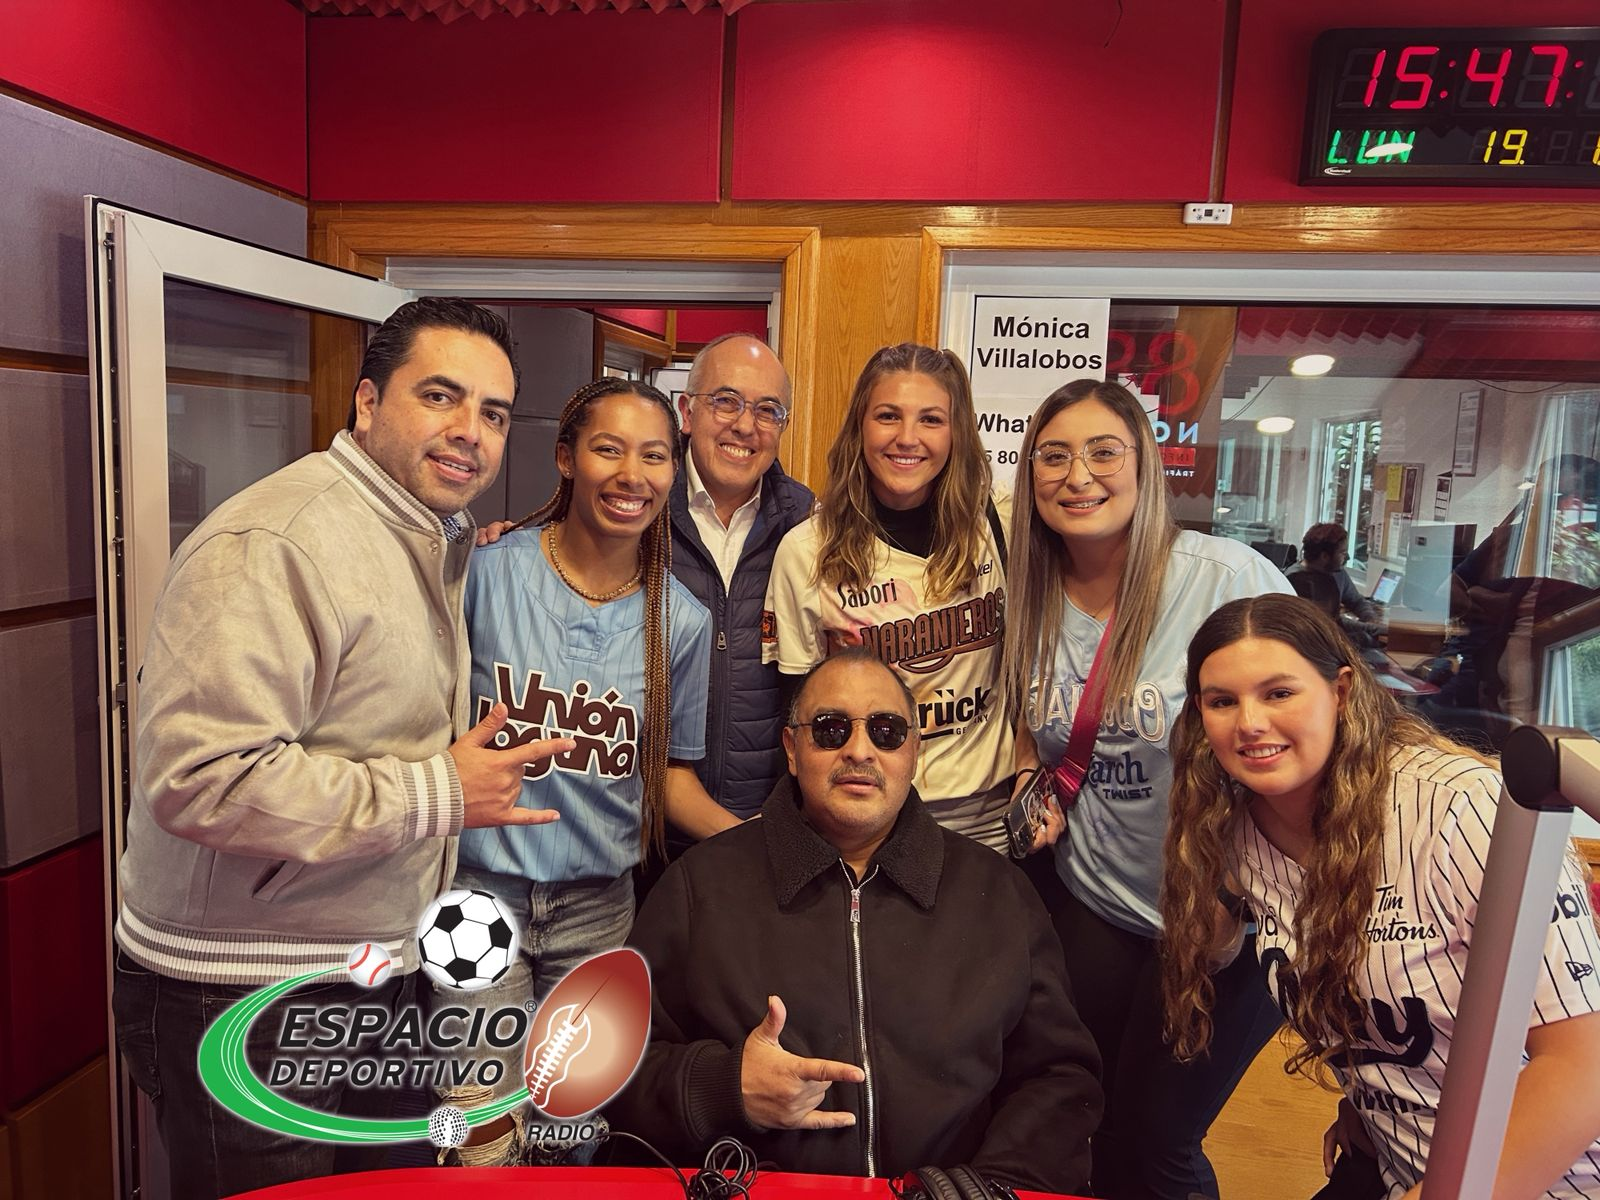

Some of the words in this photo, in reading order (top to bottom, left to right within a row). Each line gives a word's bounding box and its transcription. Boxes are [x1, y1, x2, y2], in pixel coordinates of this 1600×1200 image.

[1327, 130, 1416, 164] LUN
[993, 316, 1090, 339] Mónica
[976, 347, 1103, 370] Villalobos
[997, 450, 1019, 465] 80
[837, 577, 898, 610] Sabori
[860, 587, 1005, 665] NARANJEROS
[493, 661, 638, 744] Unión
[1102, 786, 1153, 800] TWIST
[1375, 884, 1404, 913] Tim
